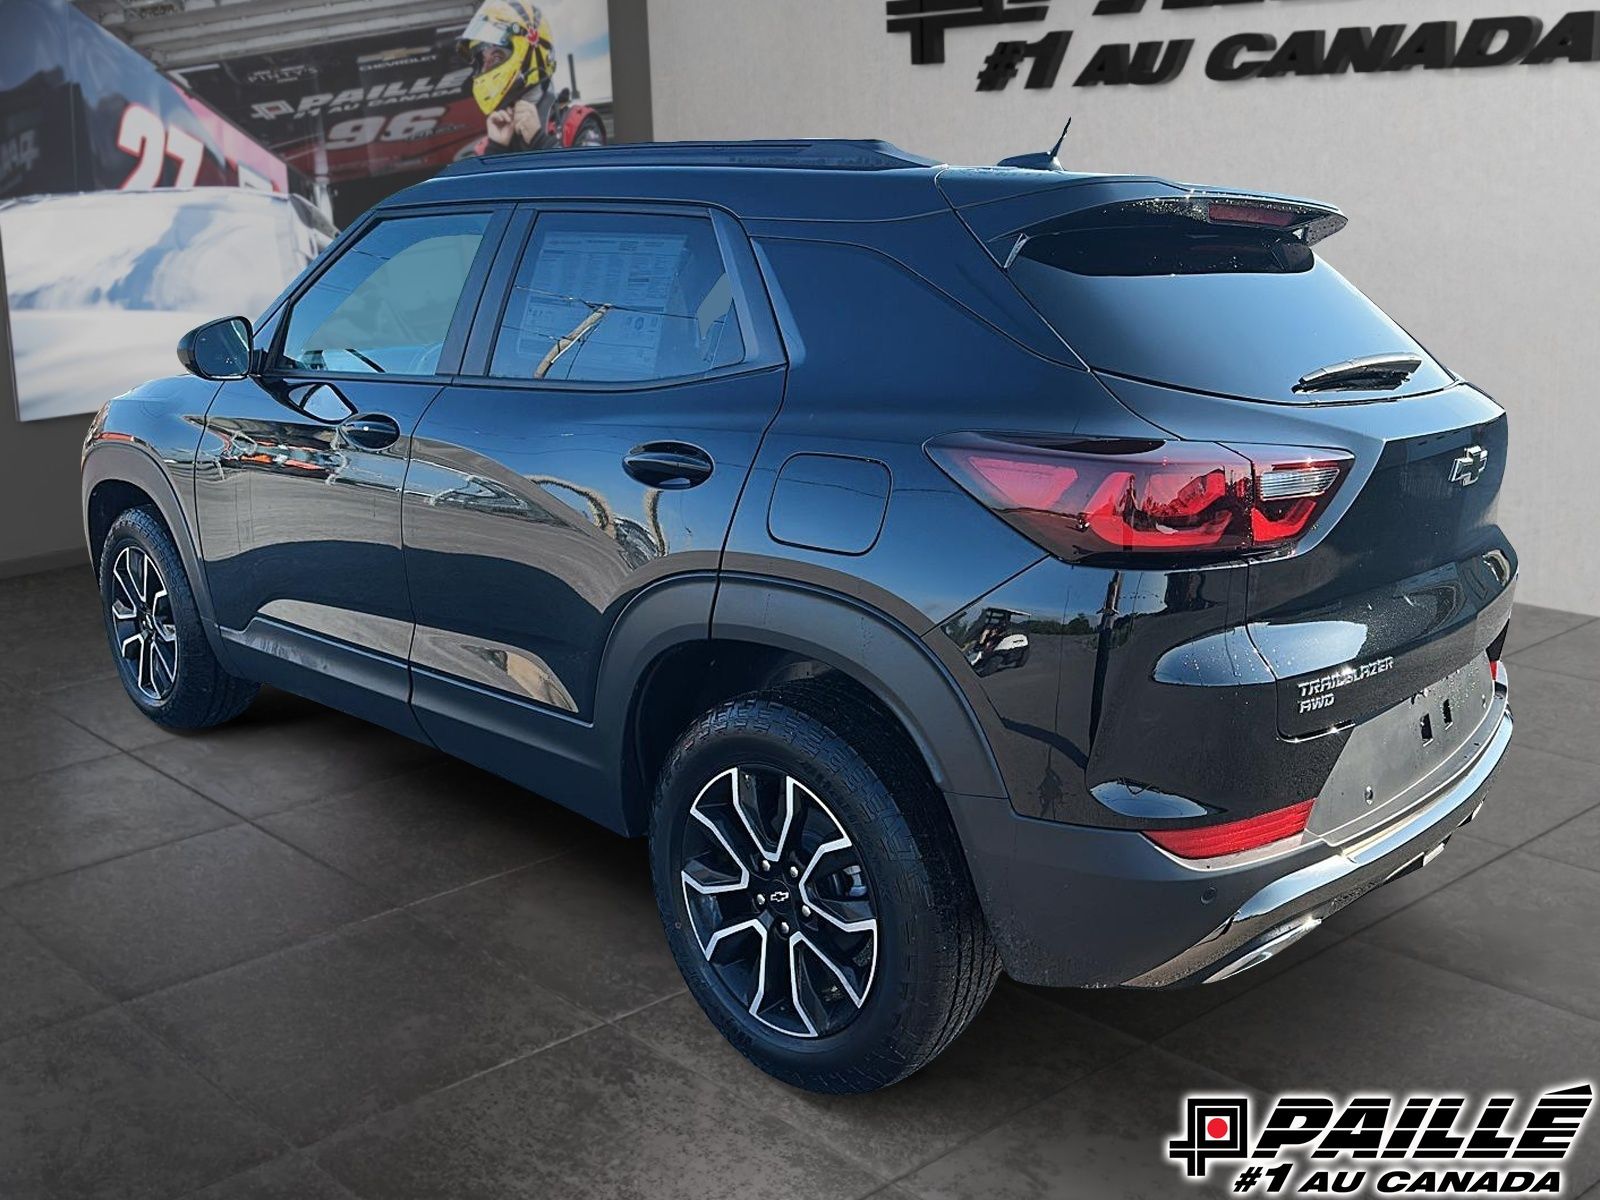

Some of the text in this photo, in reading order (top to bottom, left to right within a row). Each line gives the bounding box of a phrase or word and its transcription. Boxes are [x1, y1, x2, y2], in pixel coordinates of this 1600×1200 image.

[975, 10, 1600, 92] #1 AU CANADA
[117, 102, 205, 190] 27
[326, 106, 446, 150] 96
[1297, 656, 1394, 697] TRAILBLAZER
[1298, 692, 1335, 714] AWD
